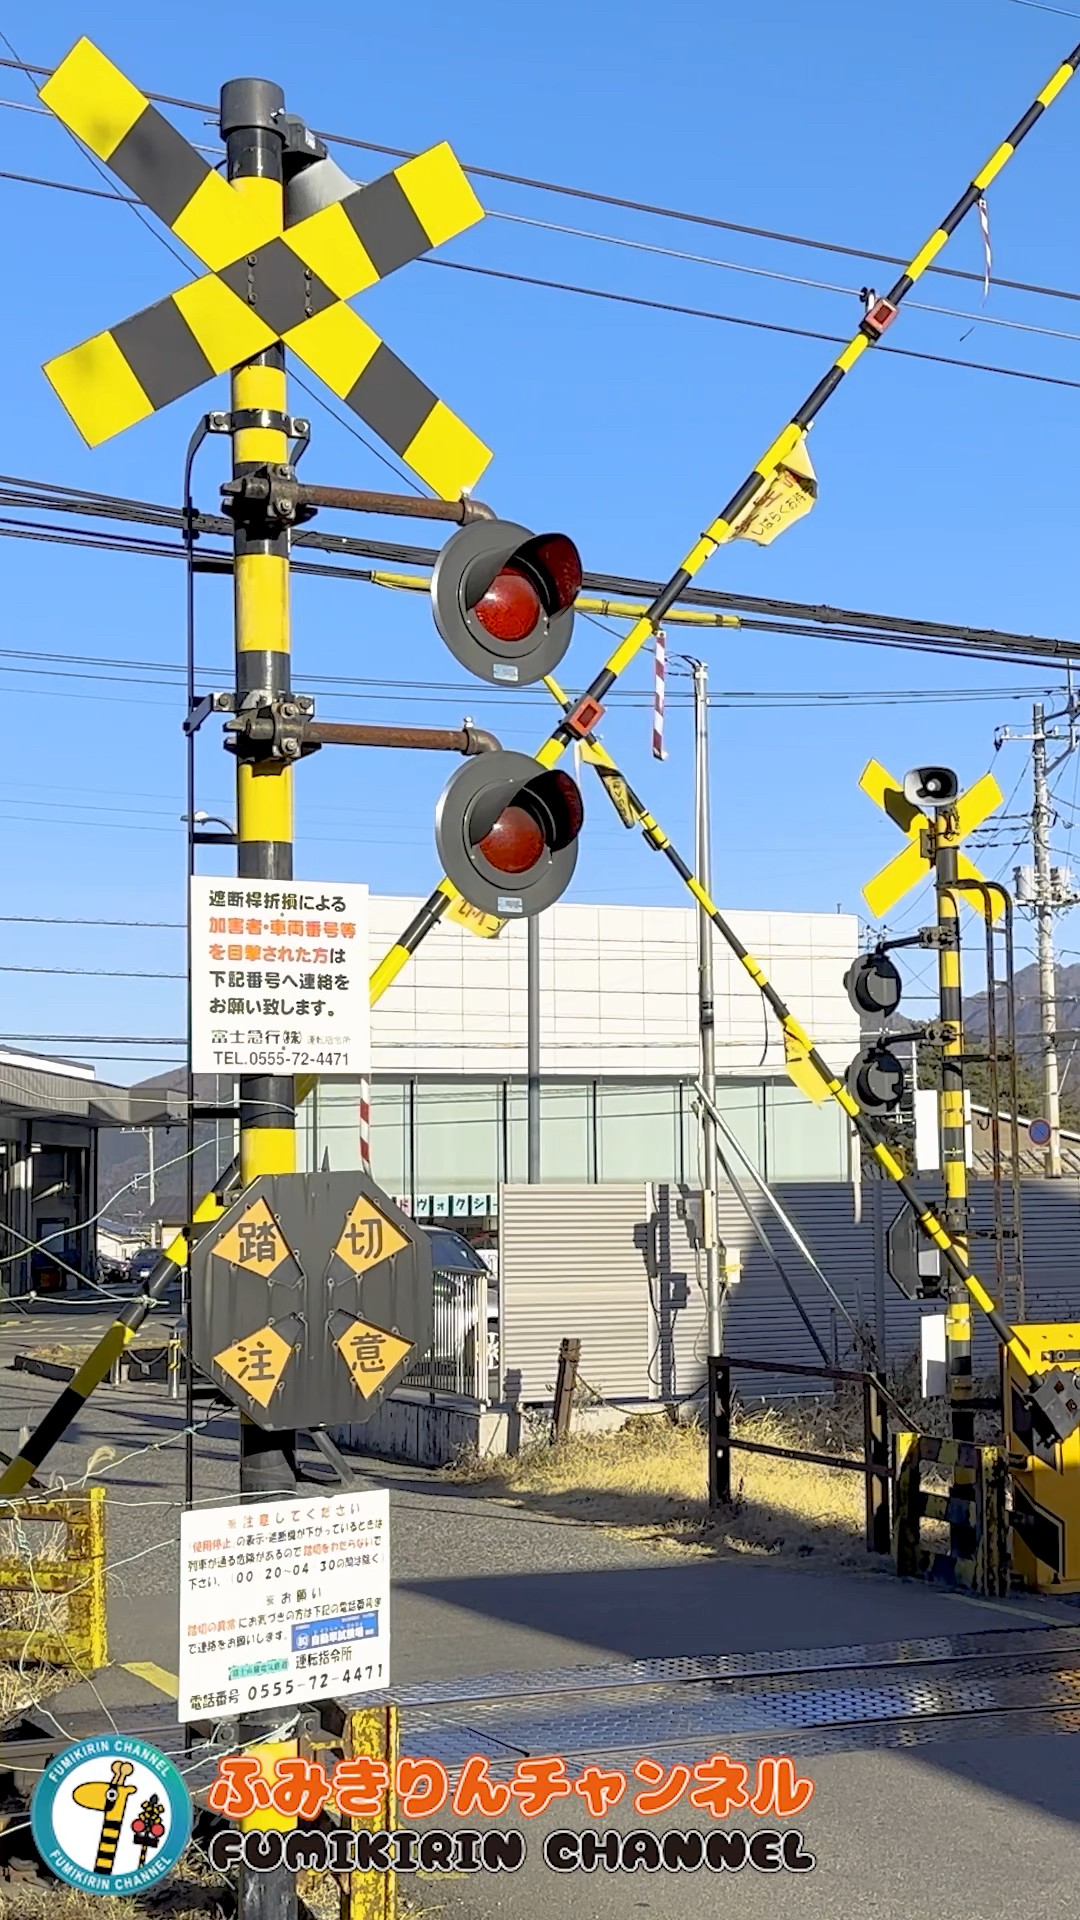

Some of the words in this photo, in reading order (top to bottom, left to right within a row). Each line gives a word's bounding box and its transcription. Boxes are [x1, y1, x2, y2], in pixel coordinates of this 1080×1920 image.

[208, 890, 347, 912] 遮断桿折損による
[208, 917, 357, 939] 加害者・車両番号等
[208, 943, 346, 964] を目撃された方は
[209, 971, 350, 991] 下記番号へ連絡を
[209, 997, 335, 1017] お願い致します。
[213, 1051, 349, 1066] TEL.0555-72-4471
[238, 1221, 277, 1263] 踏
[345, 1218, 382, 1259] 切
[238, 1341, 275, 1382] 注
[350, 1332, 386, 1373] 意
[295, 1646, 353, 1670] 運転指令所
[190, 1688, 240, 1711] 電話番号
[248, 1663, 383, 1700] 0555-72-4471
